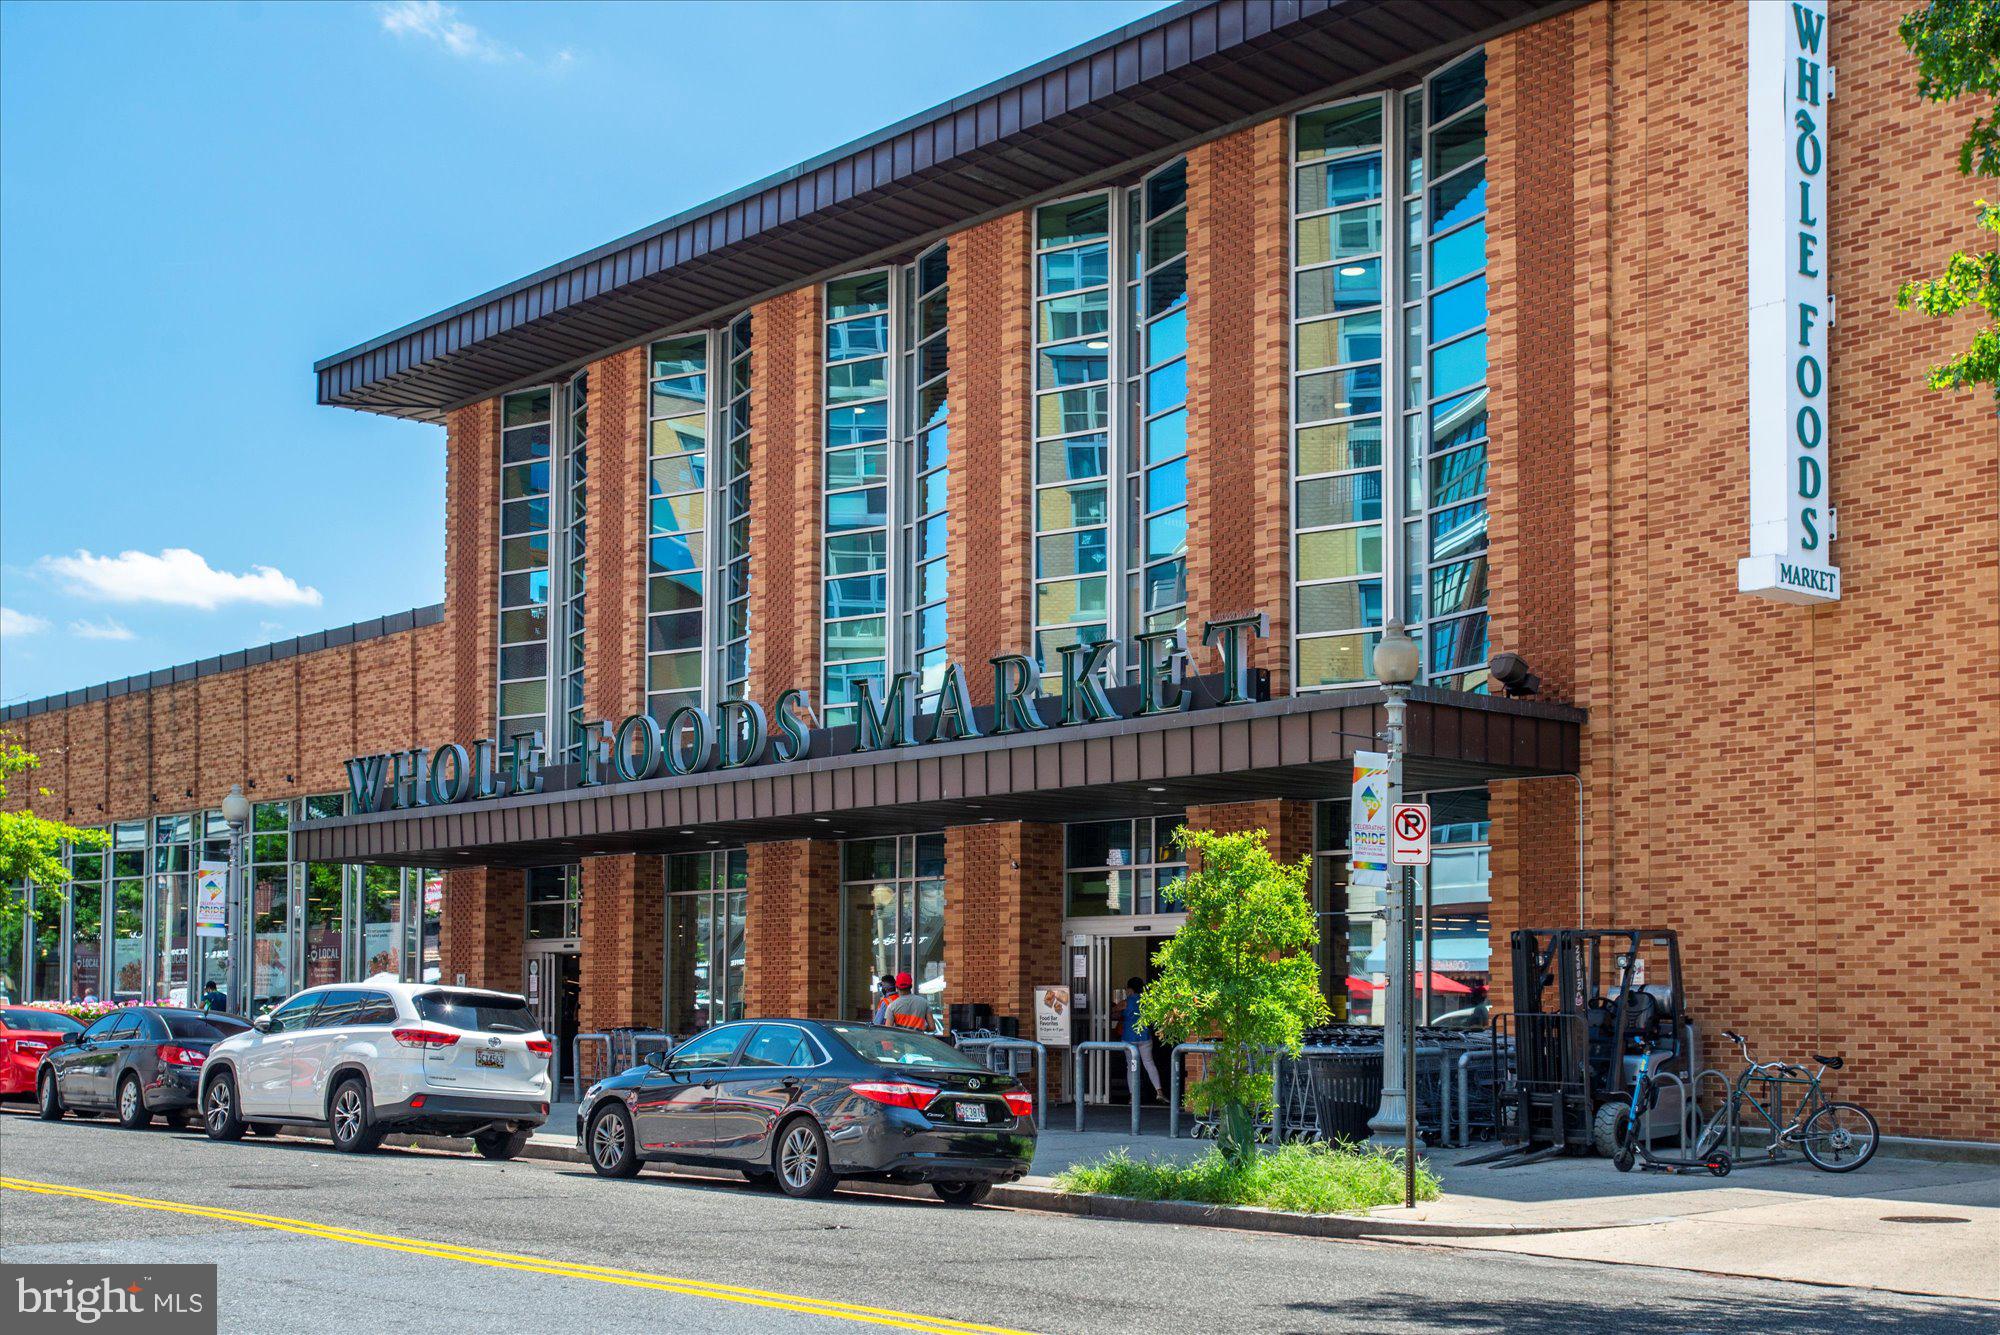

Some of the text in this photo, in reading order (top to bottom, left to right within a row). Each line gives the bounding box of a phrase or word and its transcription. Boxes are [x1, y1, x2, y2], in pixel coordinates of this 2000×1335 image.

[1792, 2, 1825, 551] WHOLE FOODS
[1780, 563, 1836, 593] MARKET
[343, 612, 1270, 813] WHOLE FOODS MARKET
[1354, 831, 1386, 845] PRIDE
[199, 905, 225, 914] PRIDE
[319, 948, 339, 959] LOCAL
